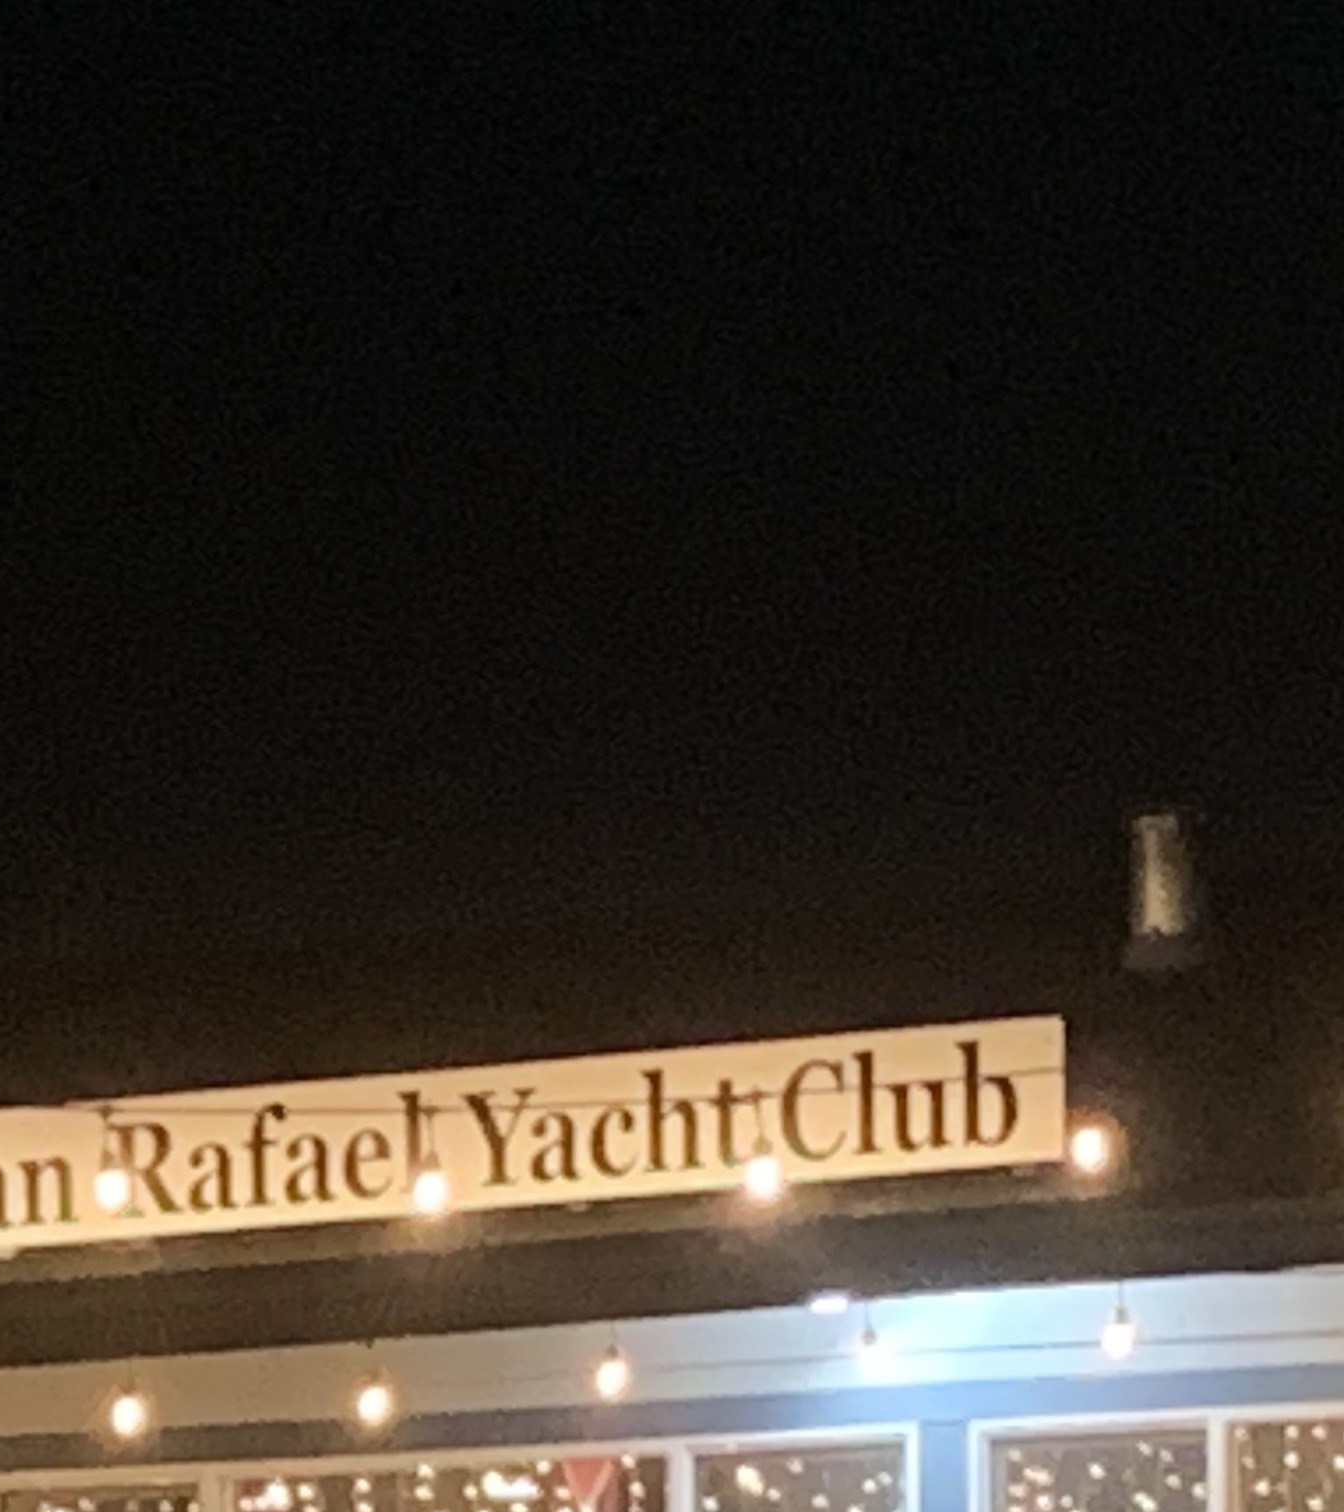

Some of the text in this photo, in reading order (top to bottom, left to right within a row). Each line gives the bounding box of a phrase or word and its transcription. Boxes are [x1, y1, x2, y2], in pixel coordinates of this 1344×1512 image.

[106, 1089, 424, 1222] Rafael
[463, 1066, 750, 1187] Yacht
[779, 1039, 1019, 1161] Club
